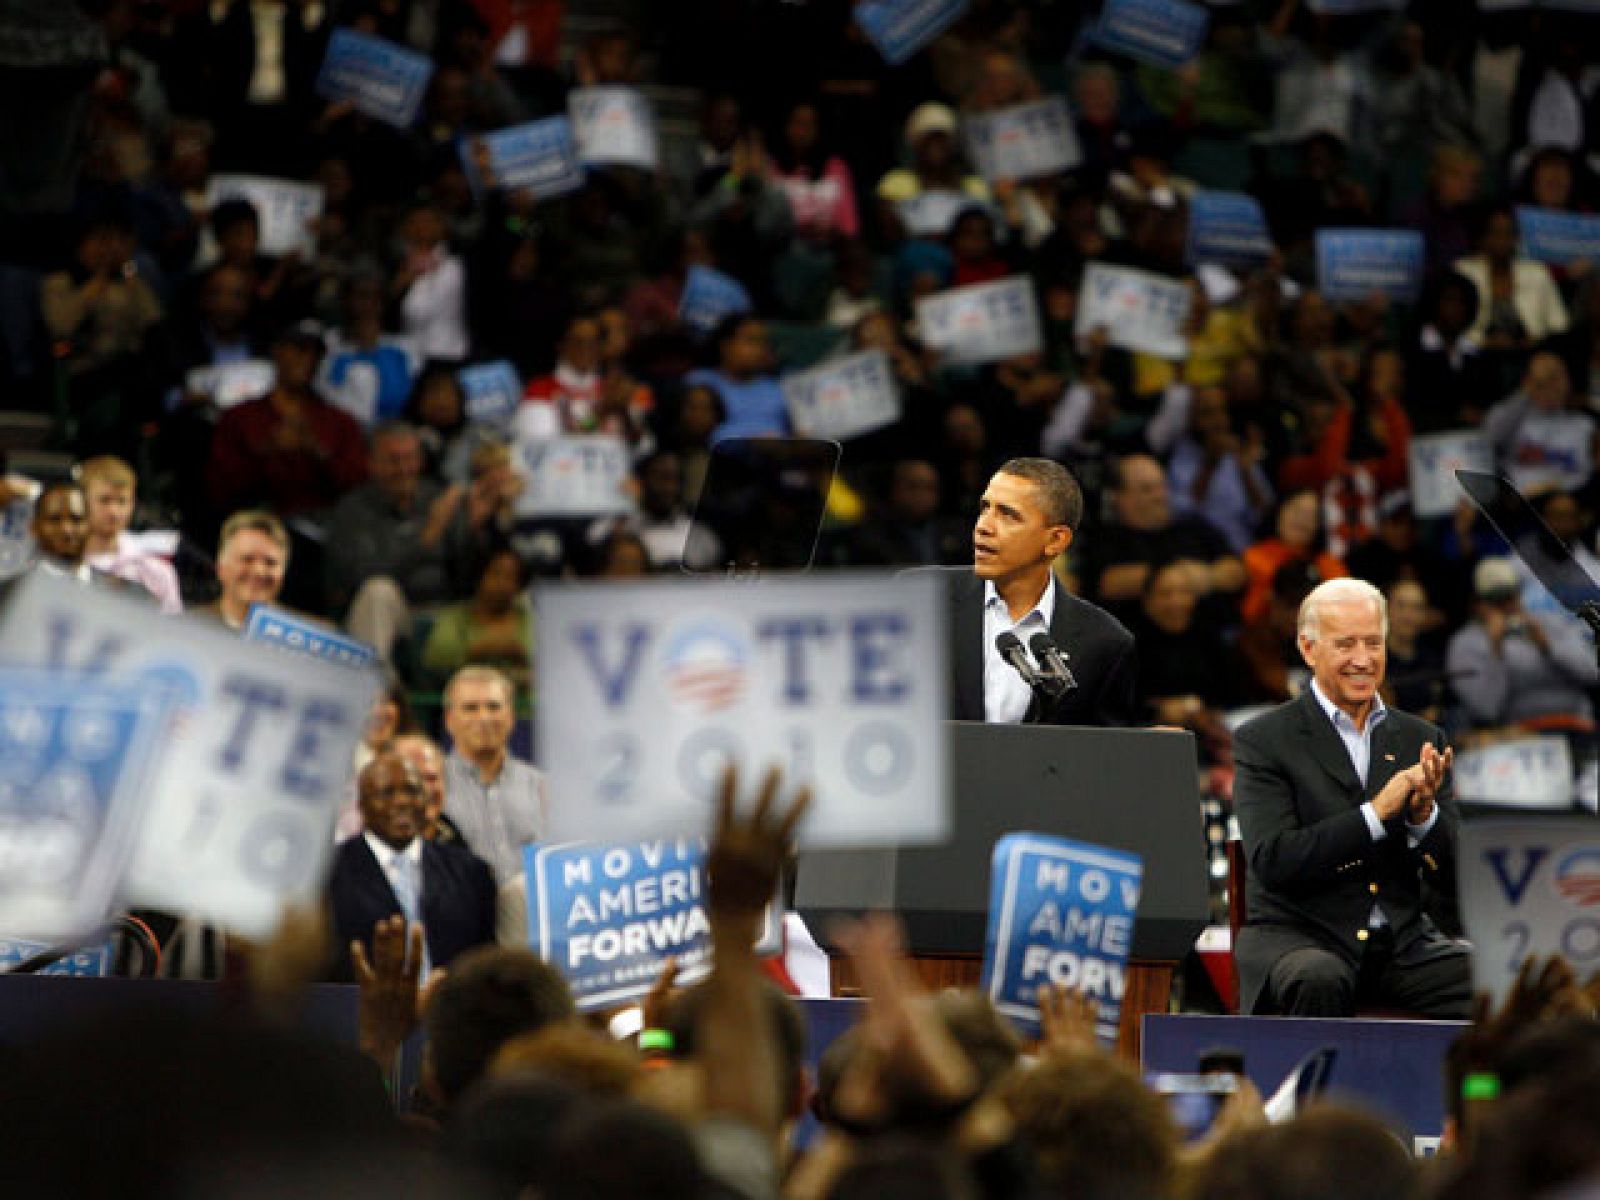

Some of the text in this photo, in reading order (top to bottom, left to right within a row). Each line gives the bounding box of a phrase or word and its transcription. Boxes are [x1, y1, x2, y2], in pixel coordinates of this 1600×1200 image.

[568, 609, 910, 711] VOTE
[563, 836, 708, 888] MOVI
[568, 905, 711, 969] FORWA
[1029, 901, 1130, 956] AME
